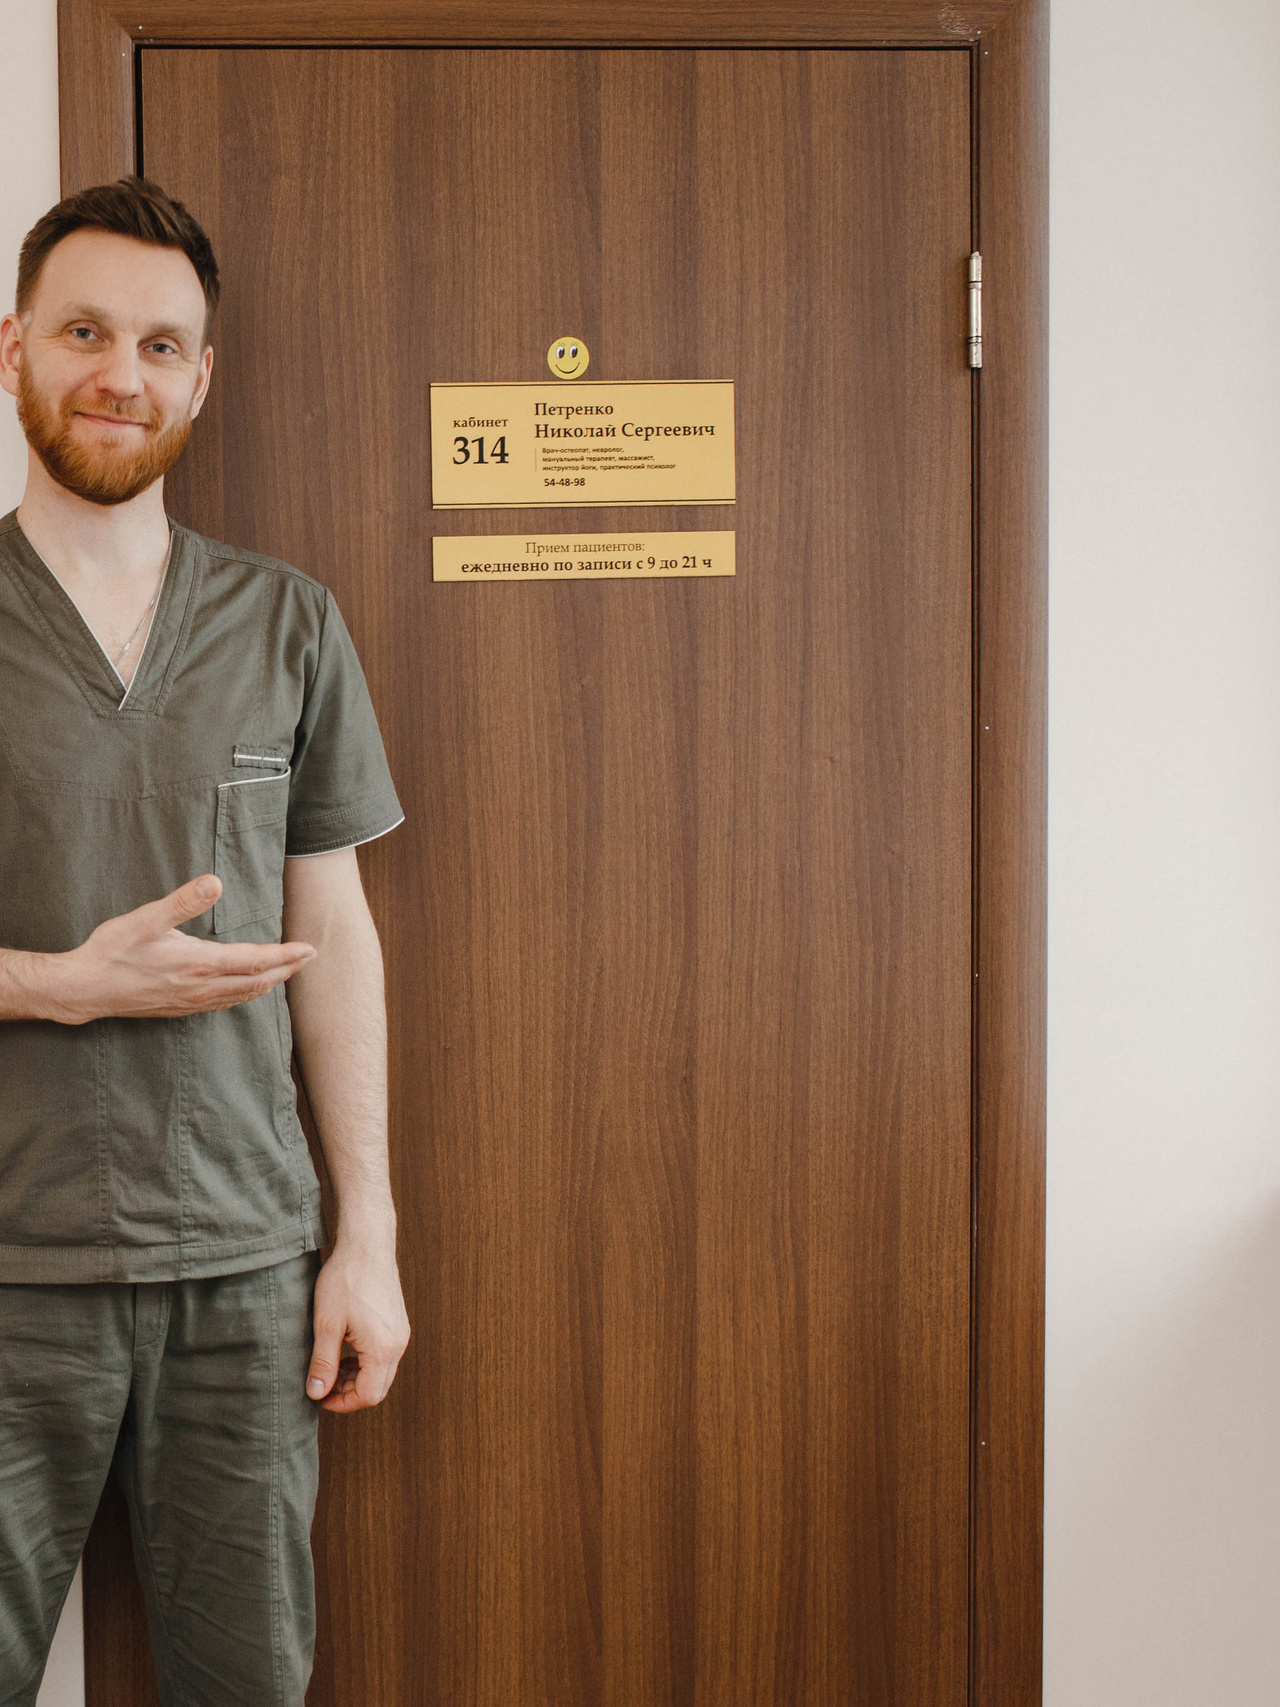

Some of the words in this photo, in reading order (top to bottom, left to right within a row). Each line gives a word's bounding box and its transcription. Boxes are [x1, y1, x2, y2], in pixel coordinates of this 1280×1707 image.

[535, 403, 613, 419] Петренко
[454, 417, 508, 427] кабинет
[535, 424, 616, 438] Николай
[622, 423, 715, 441] Сергеевич
[453, 436, 509, 464] 314
[542, 447, 591, 455] Врач-остеопат,
[543, 455, 585, 463] мануальный
[600, 463, 646, 471] практический
[545, 477, 586, 487] 54-48-98
[526, 542, 569, 556] Прием
[574, 542, 645, 555] пациентов:
[461, 561, 550, 574] ежедневно
[554, 562, 573, 571] по
[578, 561, 632, 571] записи
[637, 561, 644, 570] с
[648, 557, 656, 570] 9
[660, 559, 678, 572] до
[682, 556, 697, 569] 21
[702, 558, 712, 568] ч
